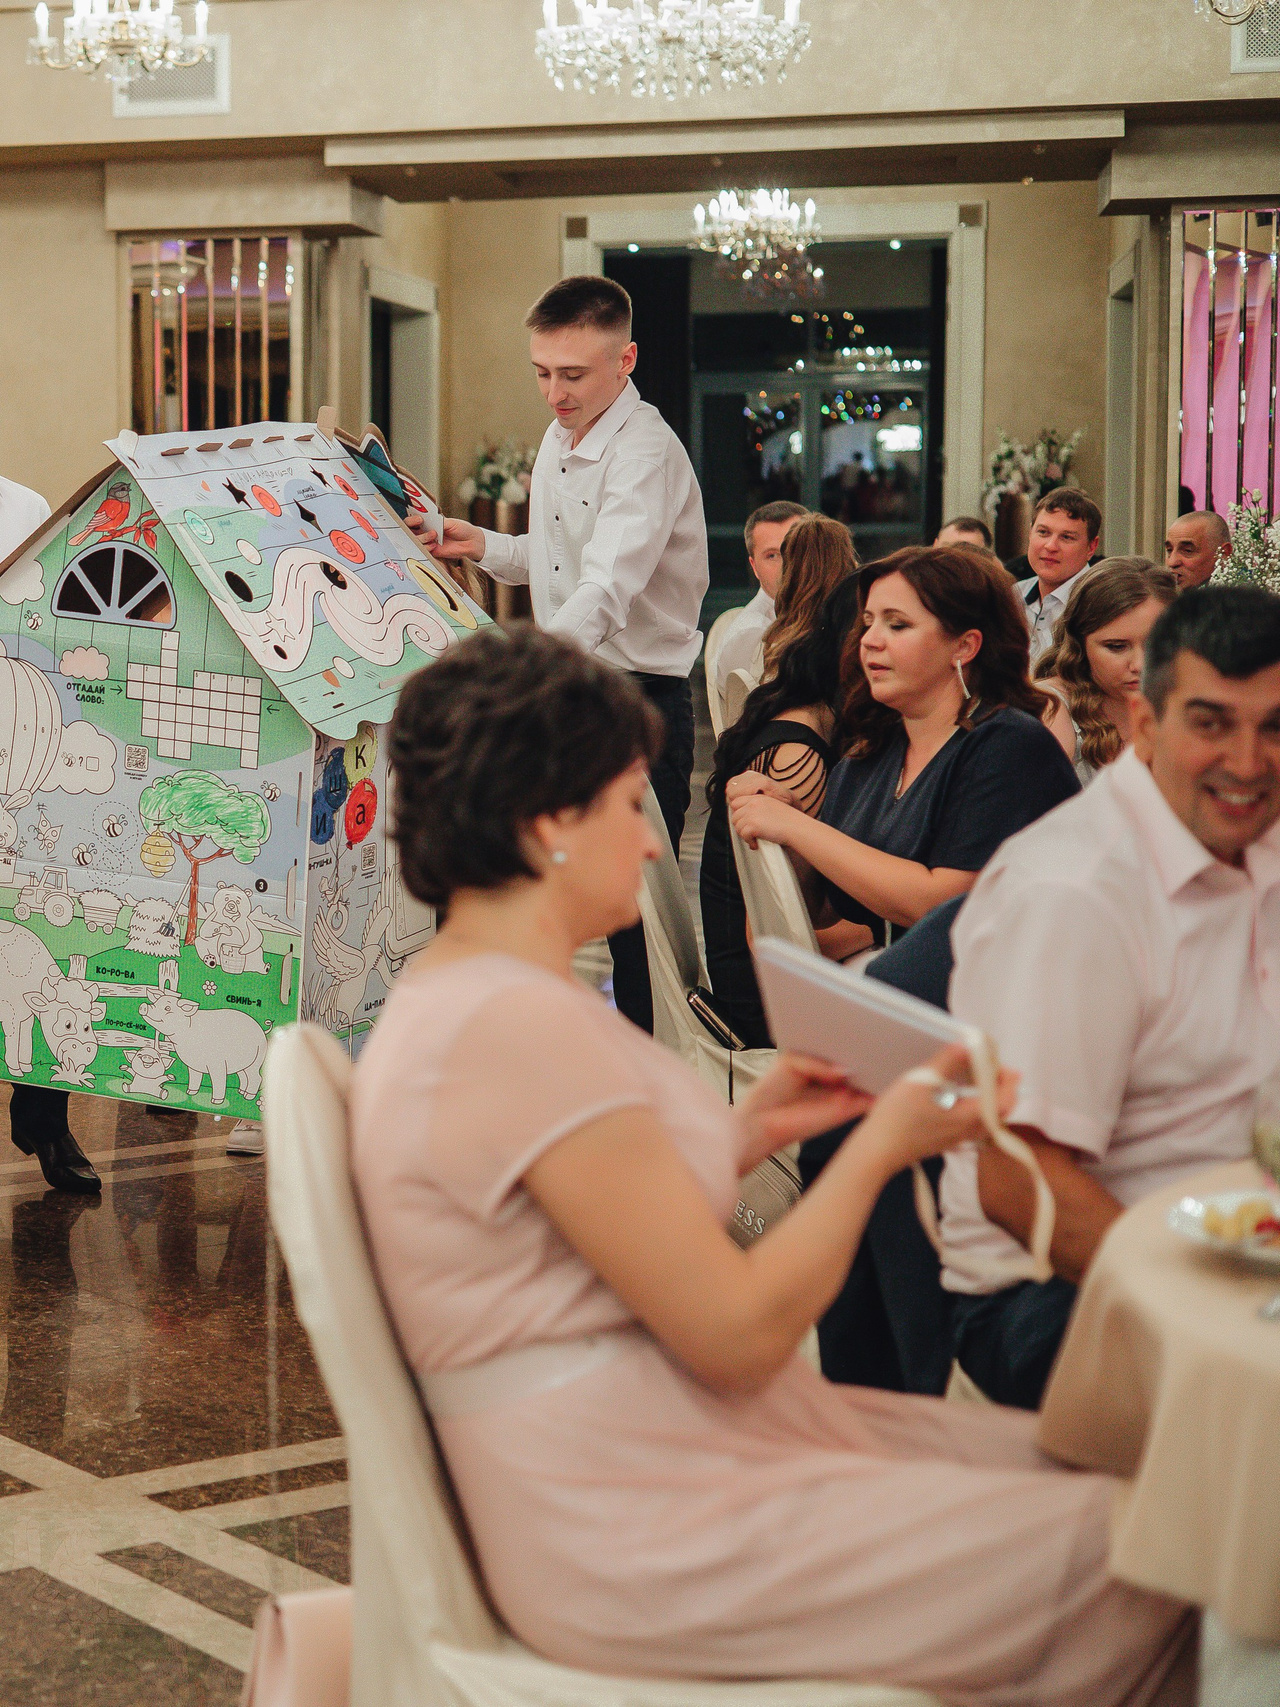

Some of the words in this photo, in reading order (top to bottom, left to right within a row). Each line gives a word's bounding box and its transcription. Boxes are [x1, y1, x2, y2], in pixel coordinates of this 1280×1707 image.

[66, 682, 105, 695] ОТГАДАЙ
[75, 693, 105, 705] СЛОВО:
[95, 965, 135, 980] КО-РО-ВА
[225, 994, 262, 1008] СВИНЬ-Я
[734, 1199, 766, 1235] ESS
